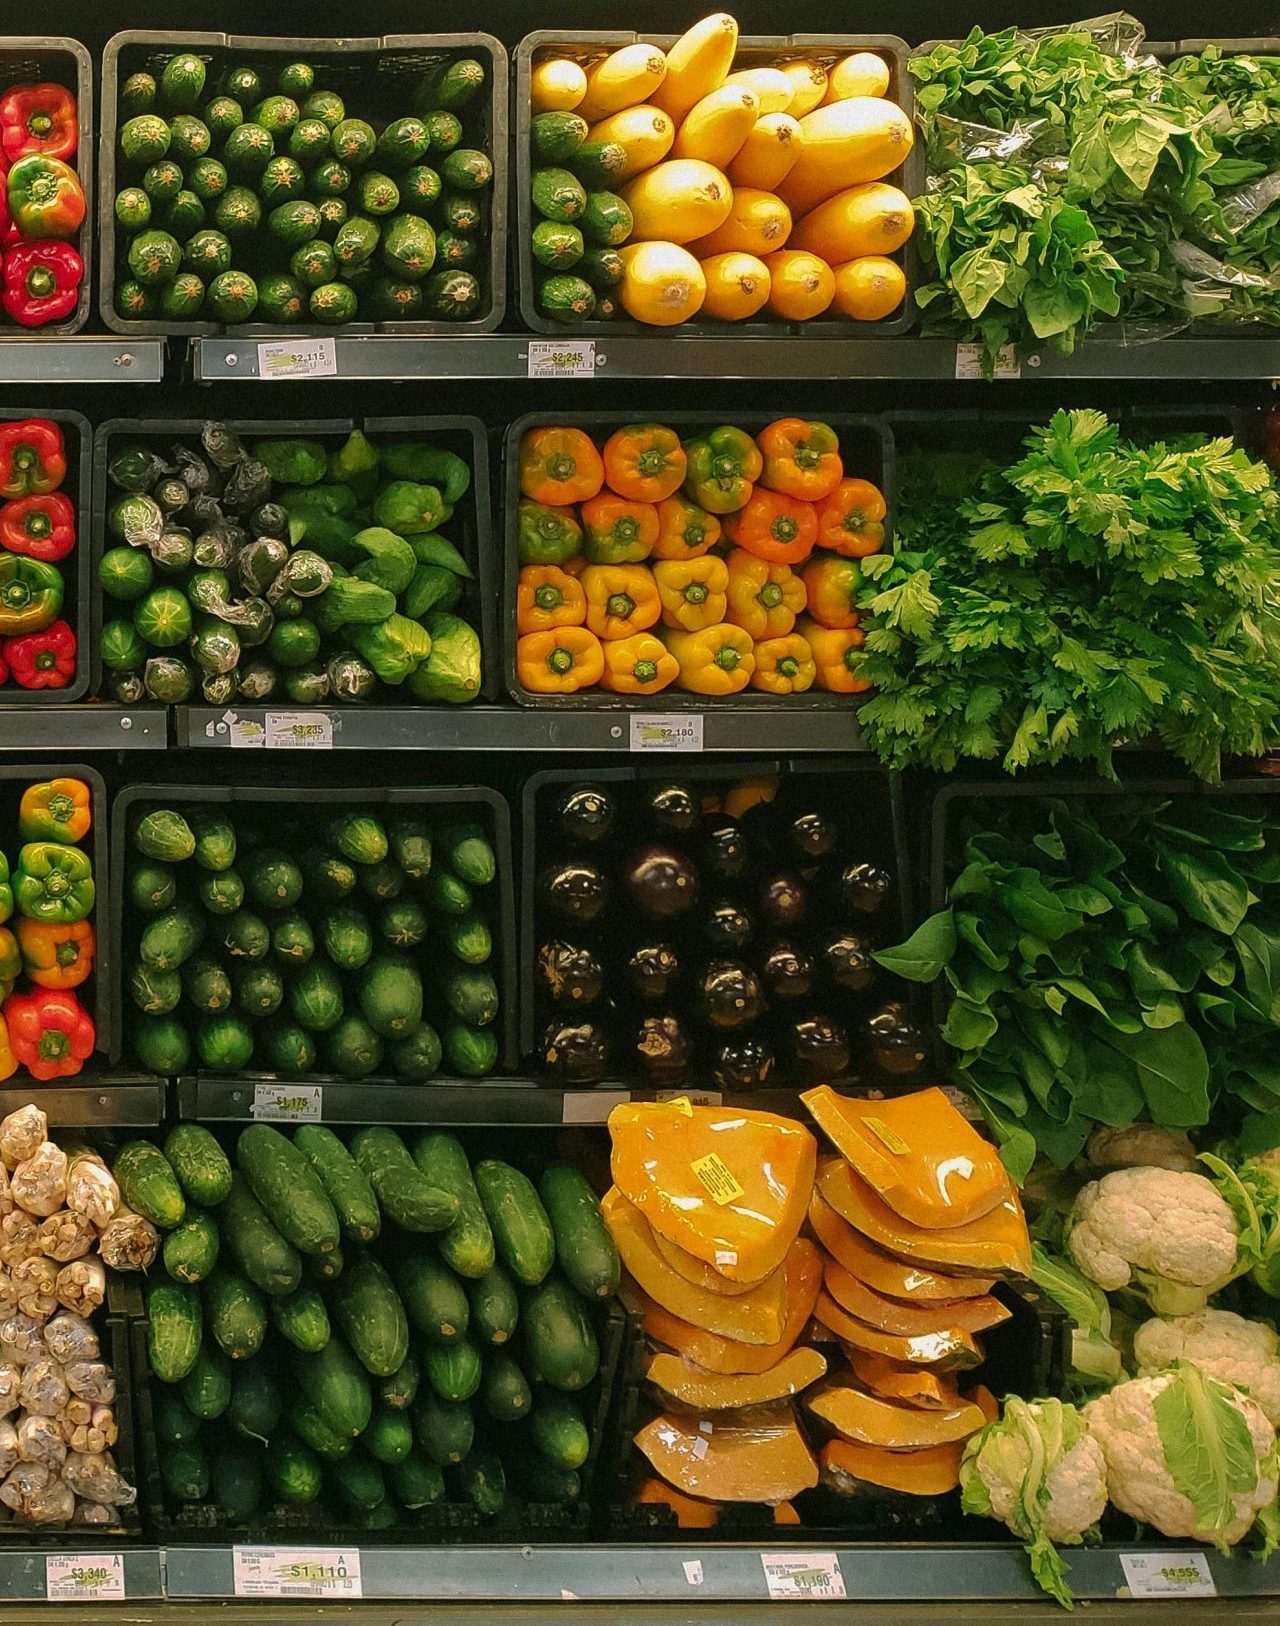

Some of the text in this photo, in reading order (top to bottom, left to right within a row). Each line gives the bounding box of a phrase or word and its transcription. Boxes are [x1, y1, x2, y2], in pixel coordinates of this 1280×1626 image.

[552, 352, 583, 363] $2,245
[292, 724, 324, 736] $3,235
[313, 1088, 320, 1098] A
[276, 1096, 308, 1108] $1,175
[113, 1556, 120, 1567] A
[338, 1555, 345, 1564] A
[71, 1568, 107, 1581] $3,340
[291, 1565, 347, 1579] $1,110
